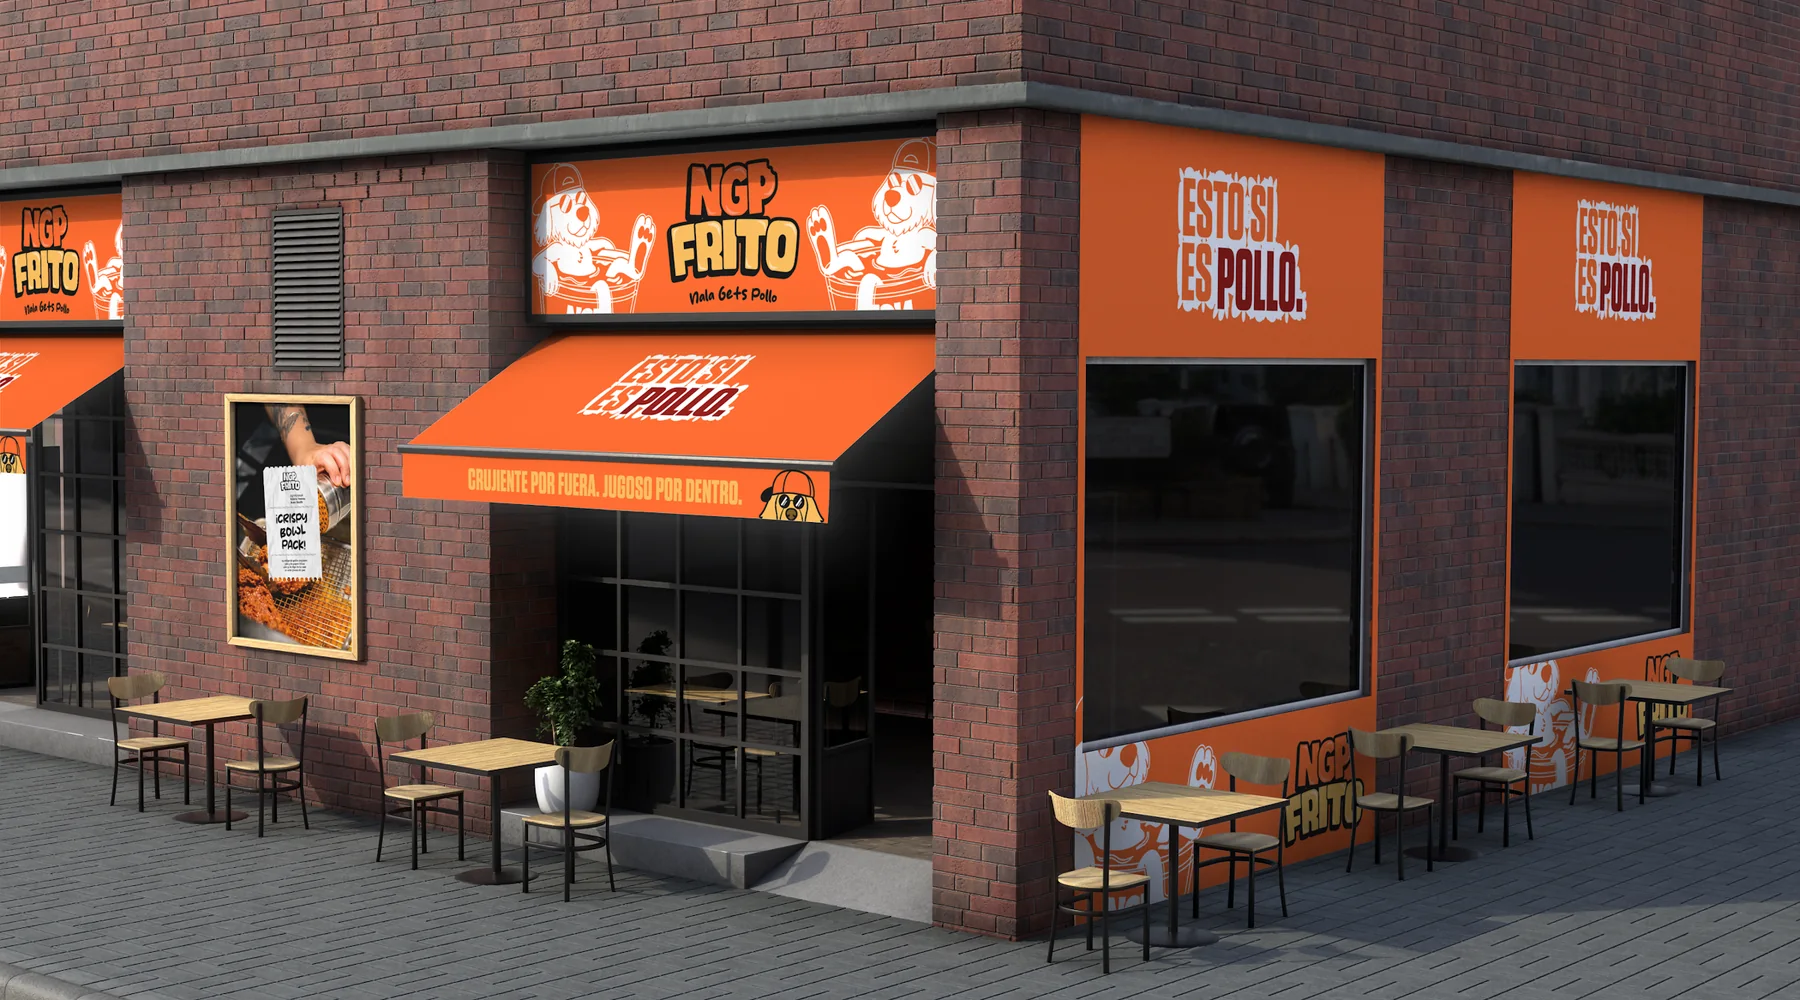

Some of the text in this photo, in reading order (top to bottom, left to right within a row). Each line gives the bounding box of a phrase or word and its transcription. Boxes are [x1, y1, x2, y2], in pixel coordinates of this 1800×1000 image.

[686, 158, 778, 220] NGP
[1182, 177, 1274, 243] ESTO SI
[22, 204, 68, 251] NGP
[667, 216, 800, 283] FRITO
[1579, 207, 1637, 258] ESTO SI
[12, 248, 80, 299] FRITO
[689, 286, 778, 305] Nala Gets Pollo
[1181, 242, 1303, 313] ES POLLO.
[1577, 258, 1654, 313] ES POLLO.
[39, 300, 55, 313] Gets
[55, 302, 70, 314] Pollo
[618, 358, 746, 385] ESTO SI
[584, 385, 740, 417] ES POLLO.
[280, 480, 300, 491] FRITO
[282, 471, 297, 482] NGP
[467, 467, 743, 505] CRUJIENTE POR FUERA. JUGOSO POR DENTRO.
[280, 524, 306, 538] BOWL
[282, 539, 306, 550] PACK!
[1295, 732, 1352, 793] NGP
[1284, 778, 1364, 848] FRITO
